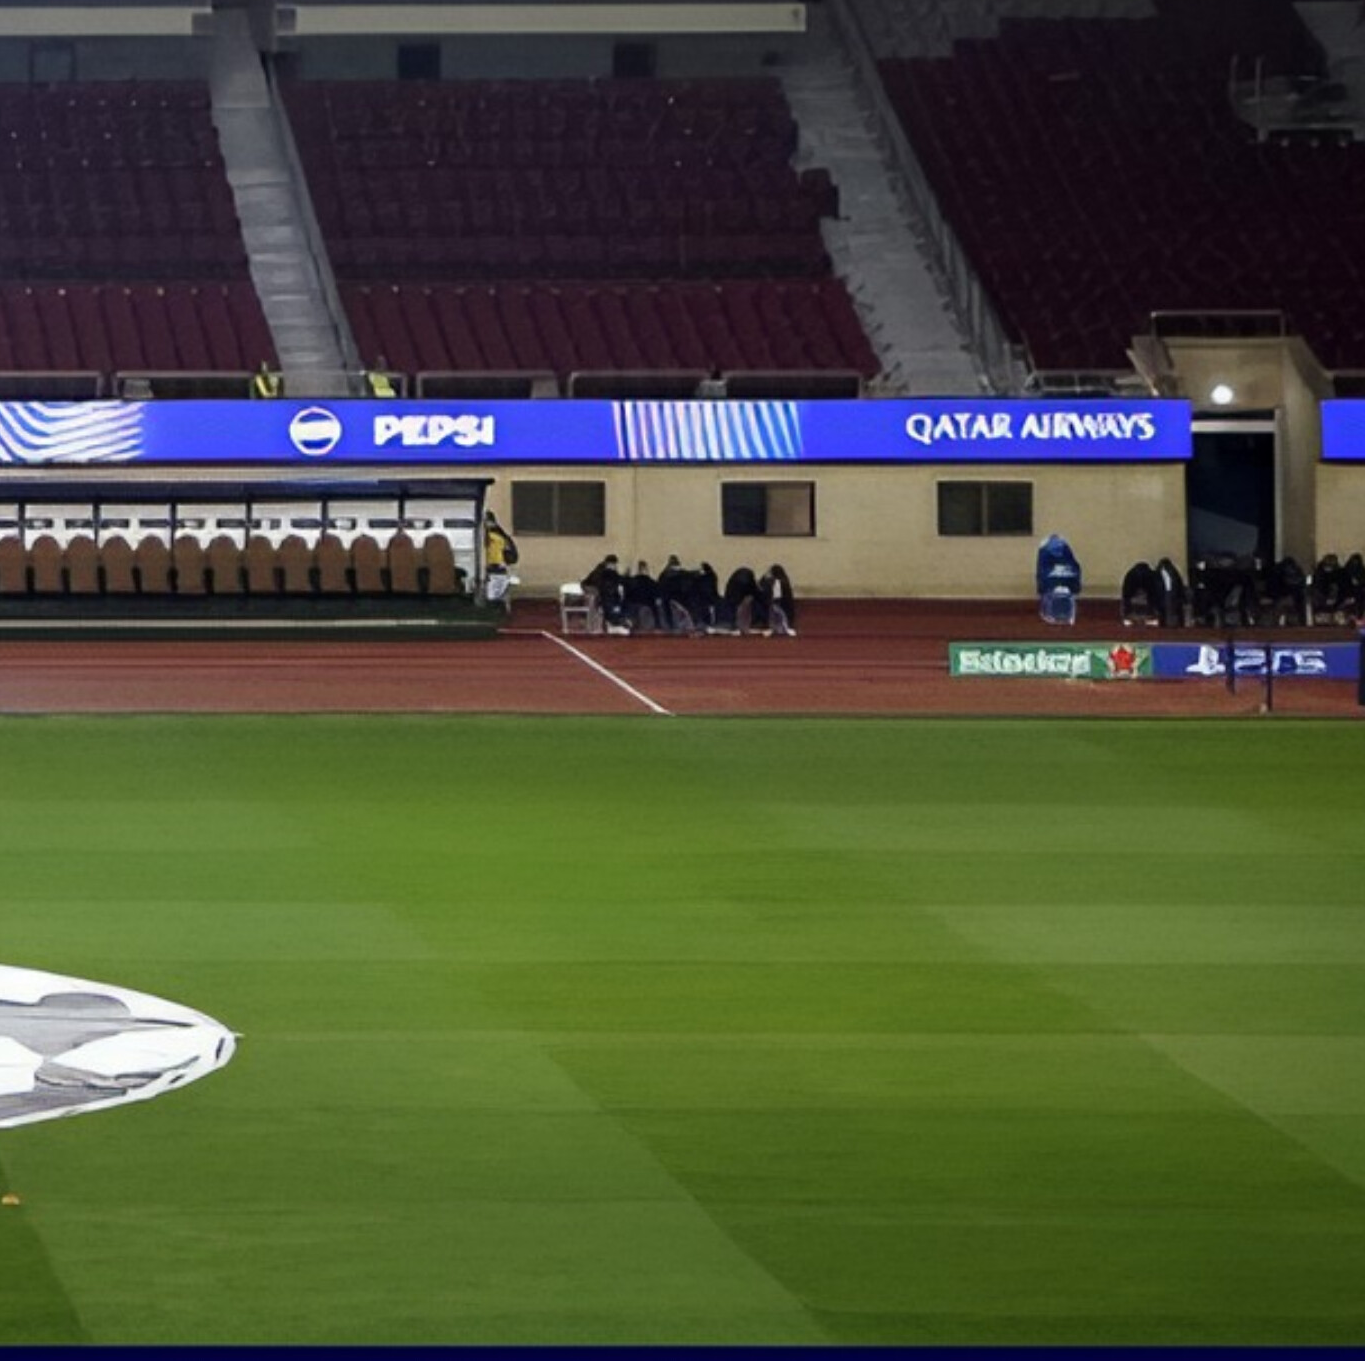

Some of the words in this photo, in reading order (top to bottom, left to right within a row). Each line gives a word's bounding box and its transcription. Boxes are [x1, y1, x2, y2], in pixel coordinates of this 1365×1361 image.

[374, 415, 494, 446] PEPSI
[906, 413, 1012, 444] QATAR
[1021, 413, 1154, 439] AIRWAYS
